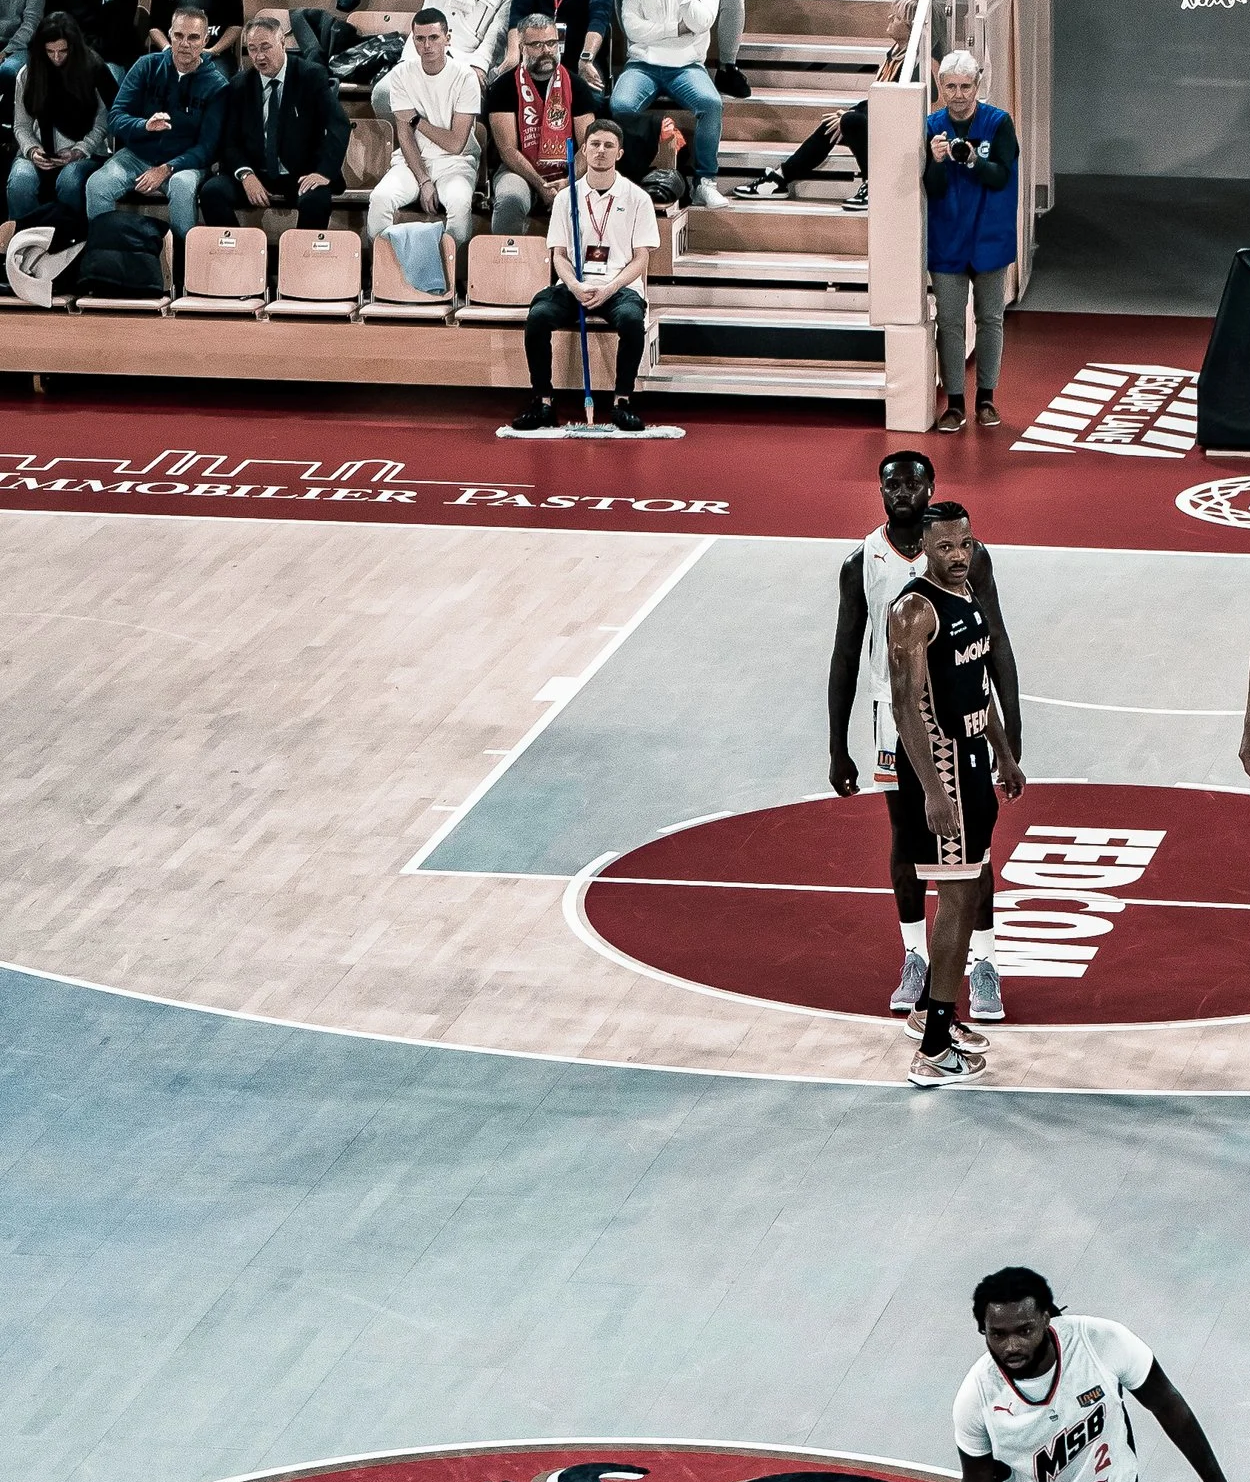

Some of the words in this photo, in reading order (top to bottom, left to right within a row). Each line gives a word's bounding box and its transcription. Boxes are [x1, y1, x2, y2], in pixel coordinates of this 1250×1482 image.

[1111, 375, 1185, 412] ESCAPE
[1085, 414, 1151, 443] LANE
[443, 487, 731, 515] PASTOR
[963, 825, 1168, 978] FEDCOM
[1094, 1443, 1112, 1475] 2
